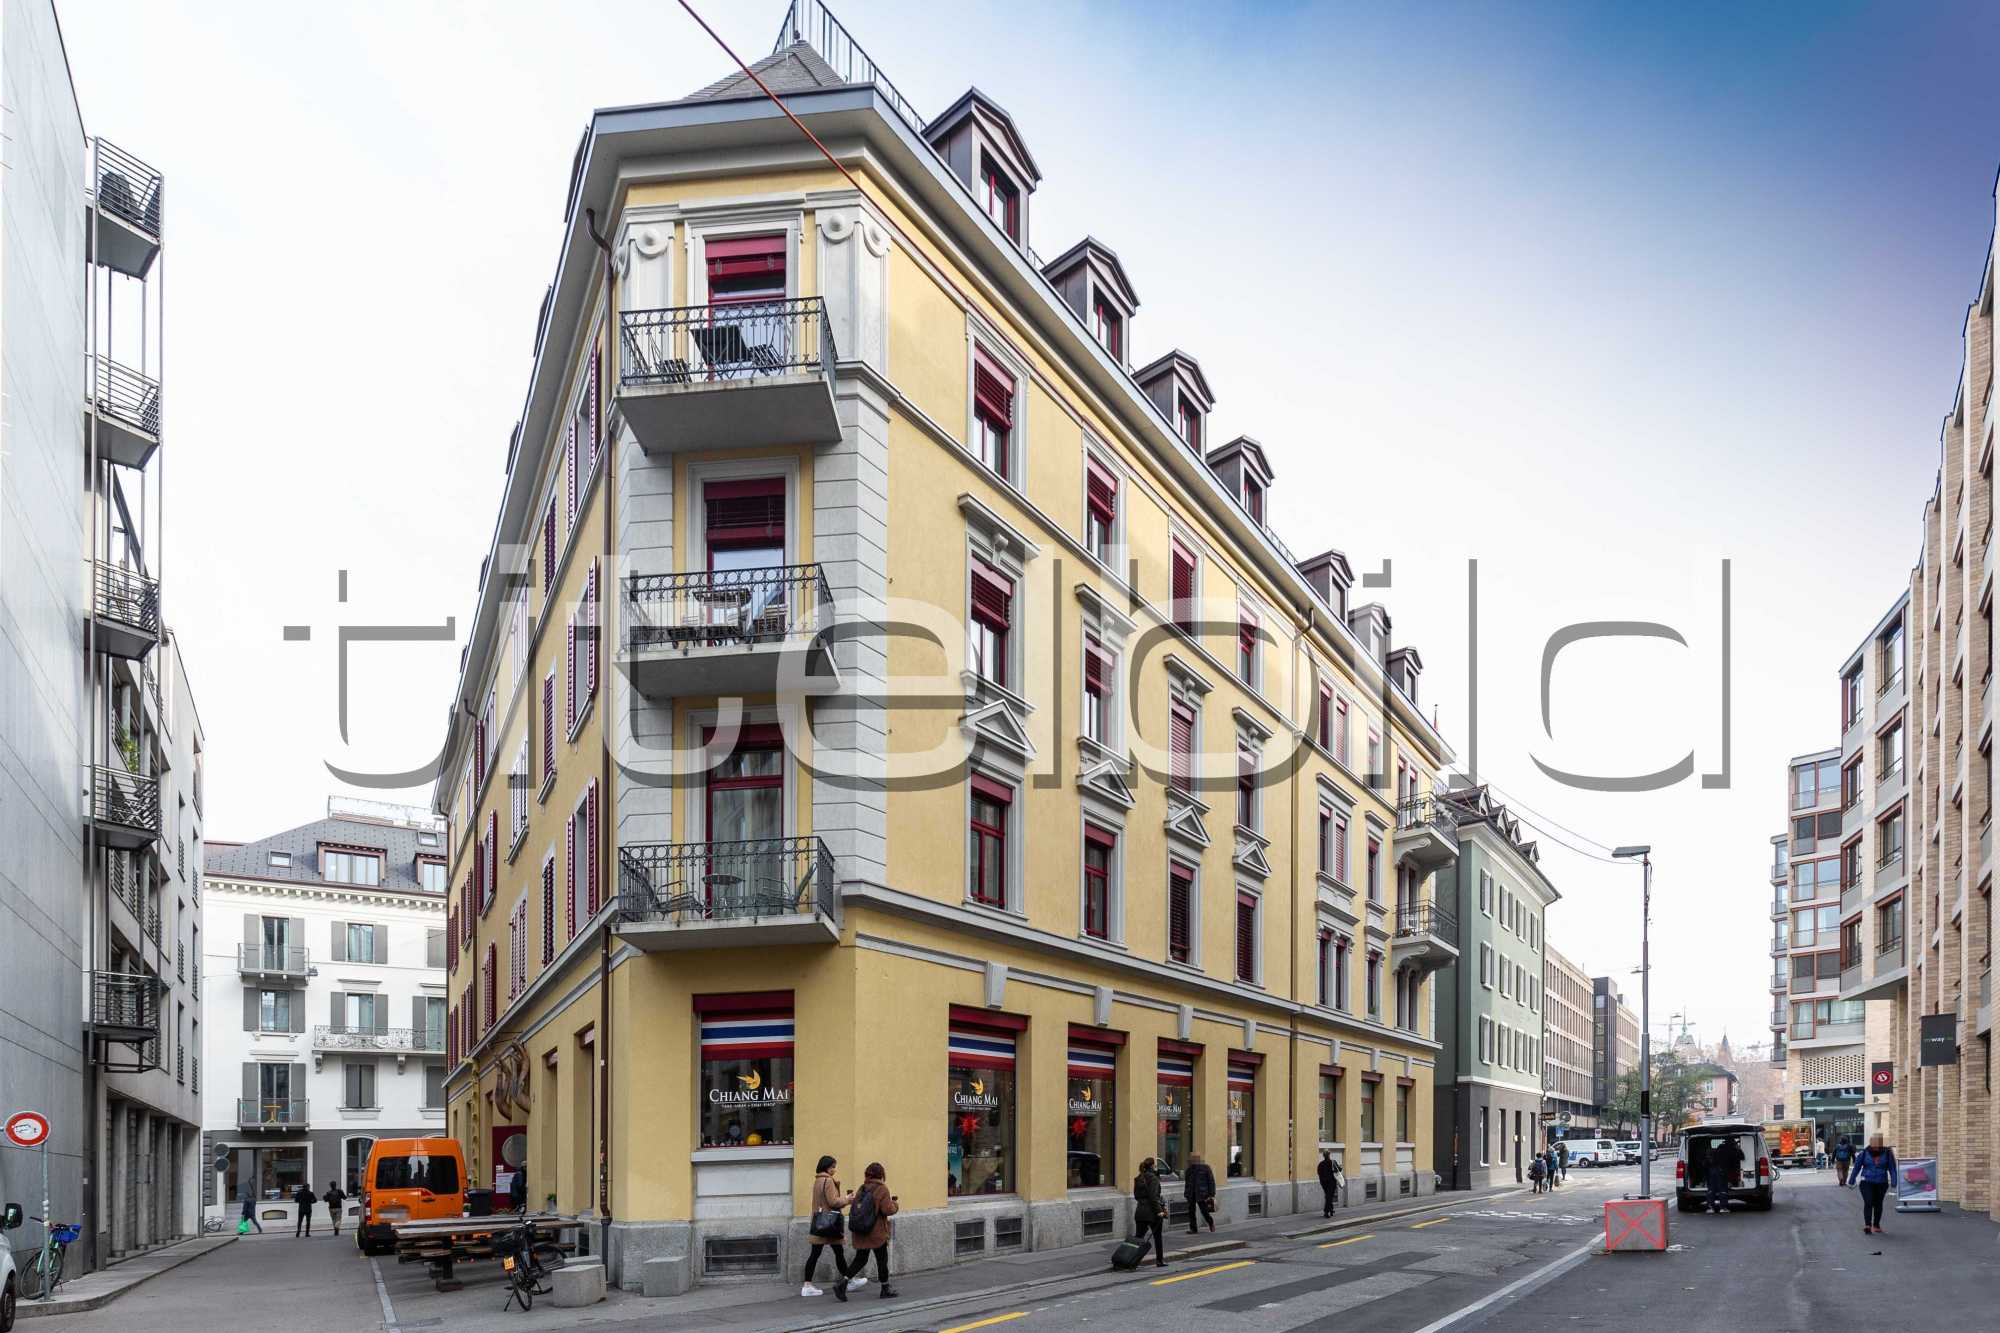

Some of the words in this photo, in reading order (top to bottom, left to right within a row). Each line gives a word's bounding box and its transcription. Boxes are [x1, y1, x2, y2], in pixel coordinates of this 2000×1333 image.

[709, 1089, 759, 1102] CHIANG
[763, 1087, 788, 1101] MAI
[954, 1091, 982, 1105] CHIANG
[984, 1093, 998, 1105] MAI
